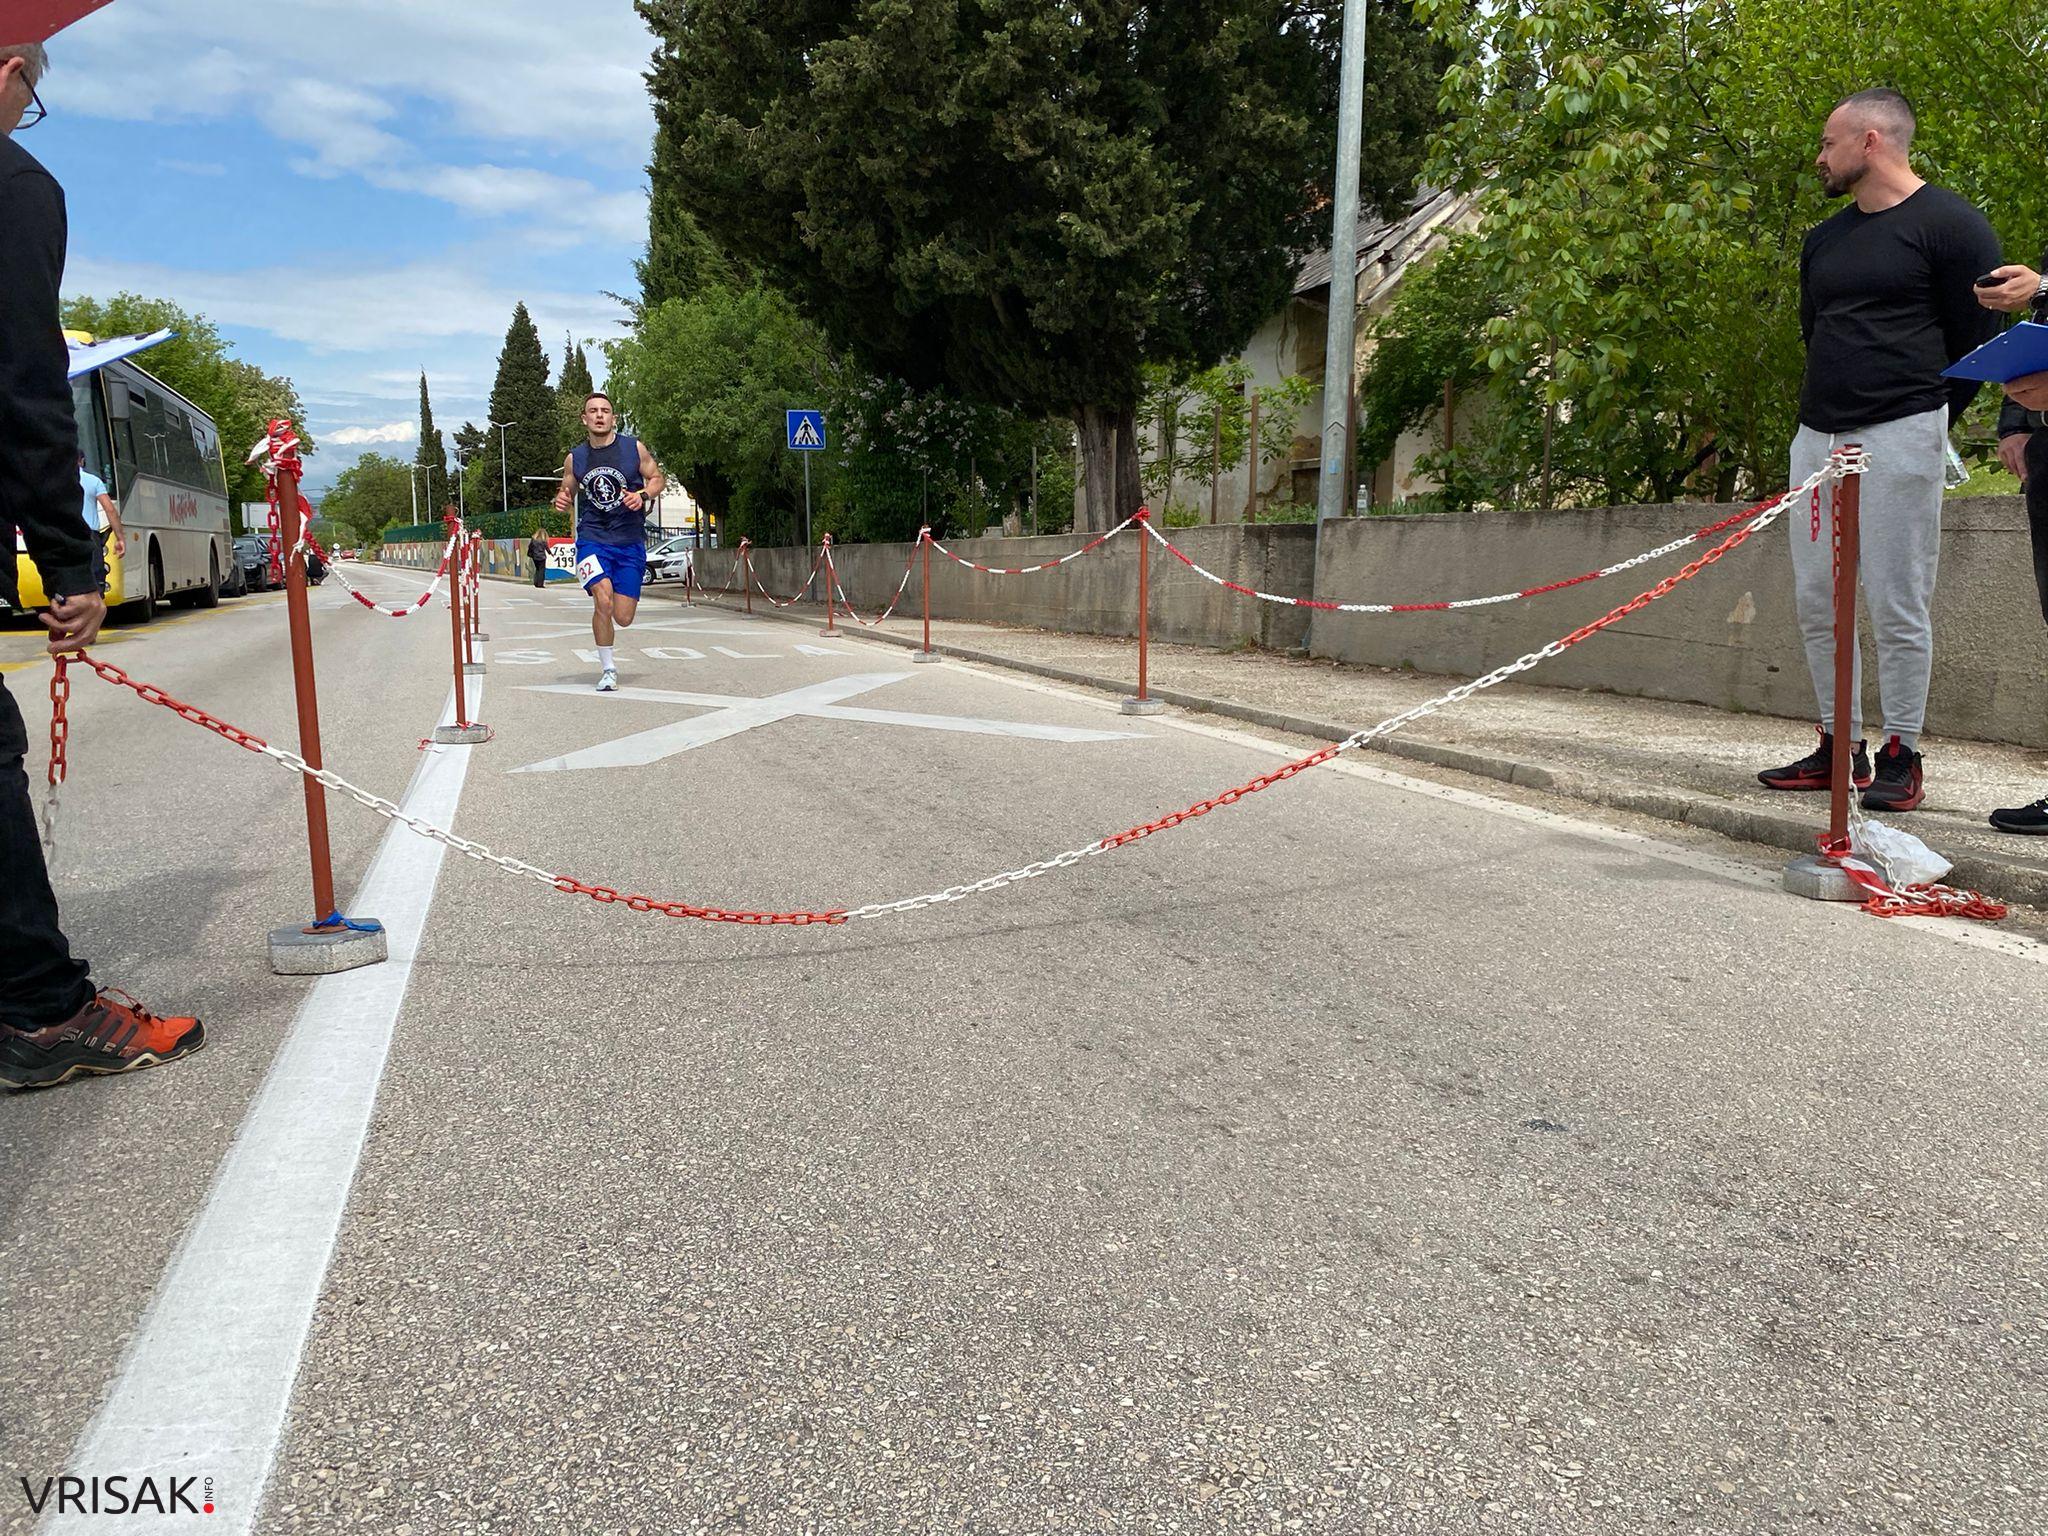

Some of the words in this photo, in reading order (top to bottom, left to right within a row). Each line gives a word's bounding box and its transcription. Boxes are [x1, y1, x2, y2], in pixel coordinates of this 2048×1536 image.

[553, 546, 576, 557] 75-9
[554, 556, 574, 568] 199
[579, 562, 595, 580] 32
